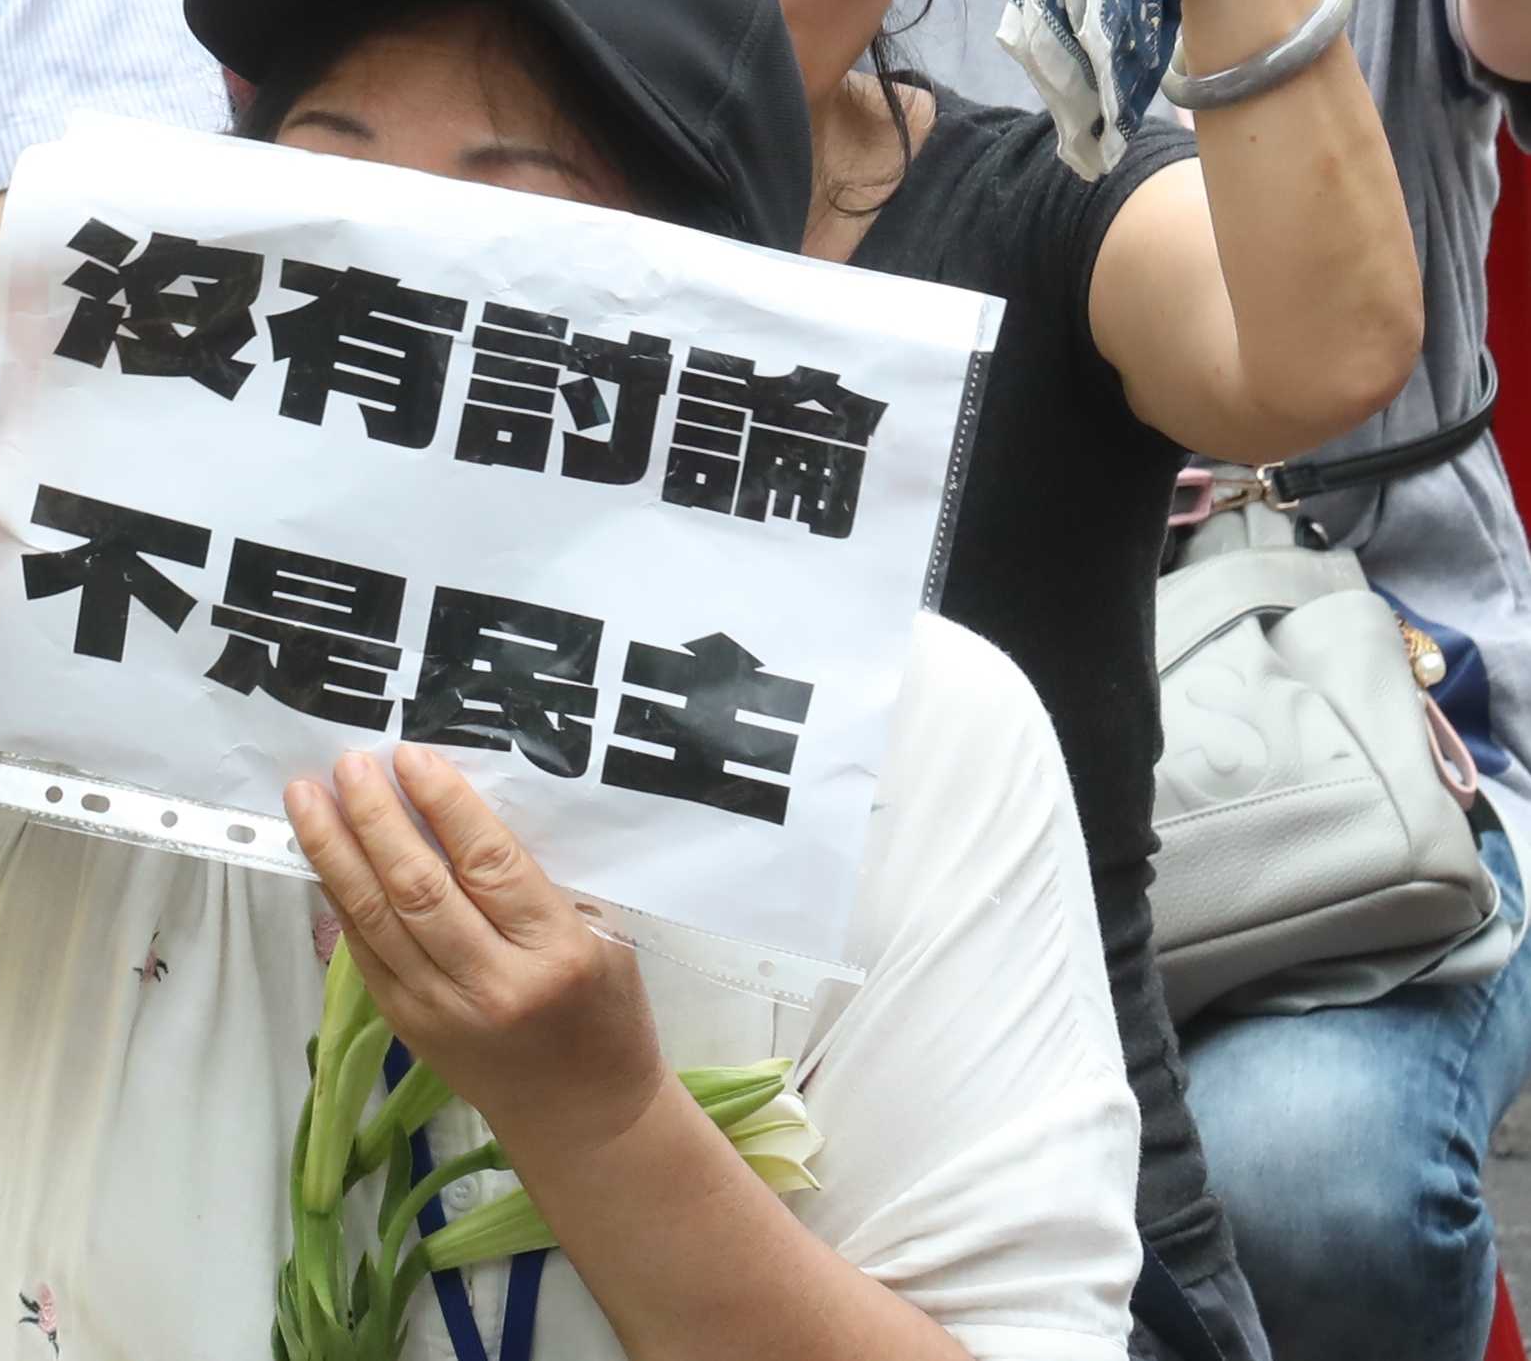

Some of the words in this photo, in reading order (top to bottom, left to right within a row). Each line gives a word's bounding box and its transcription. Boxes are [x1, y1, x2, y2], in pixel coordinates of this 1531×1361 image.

[52, 217, 890, 540] 沒有討論
[20, 483, 817, 828] 不是民主
